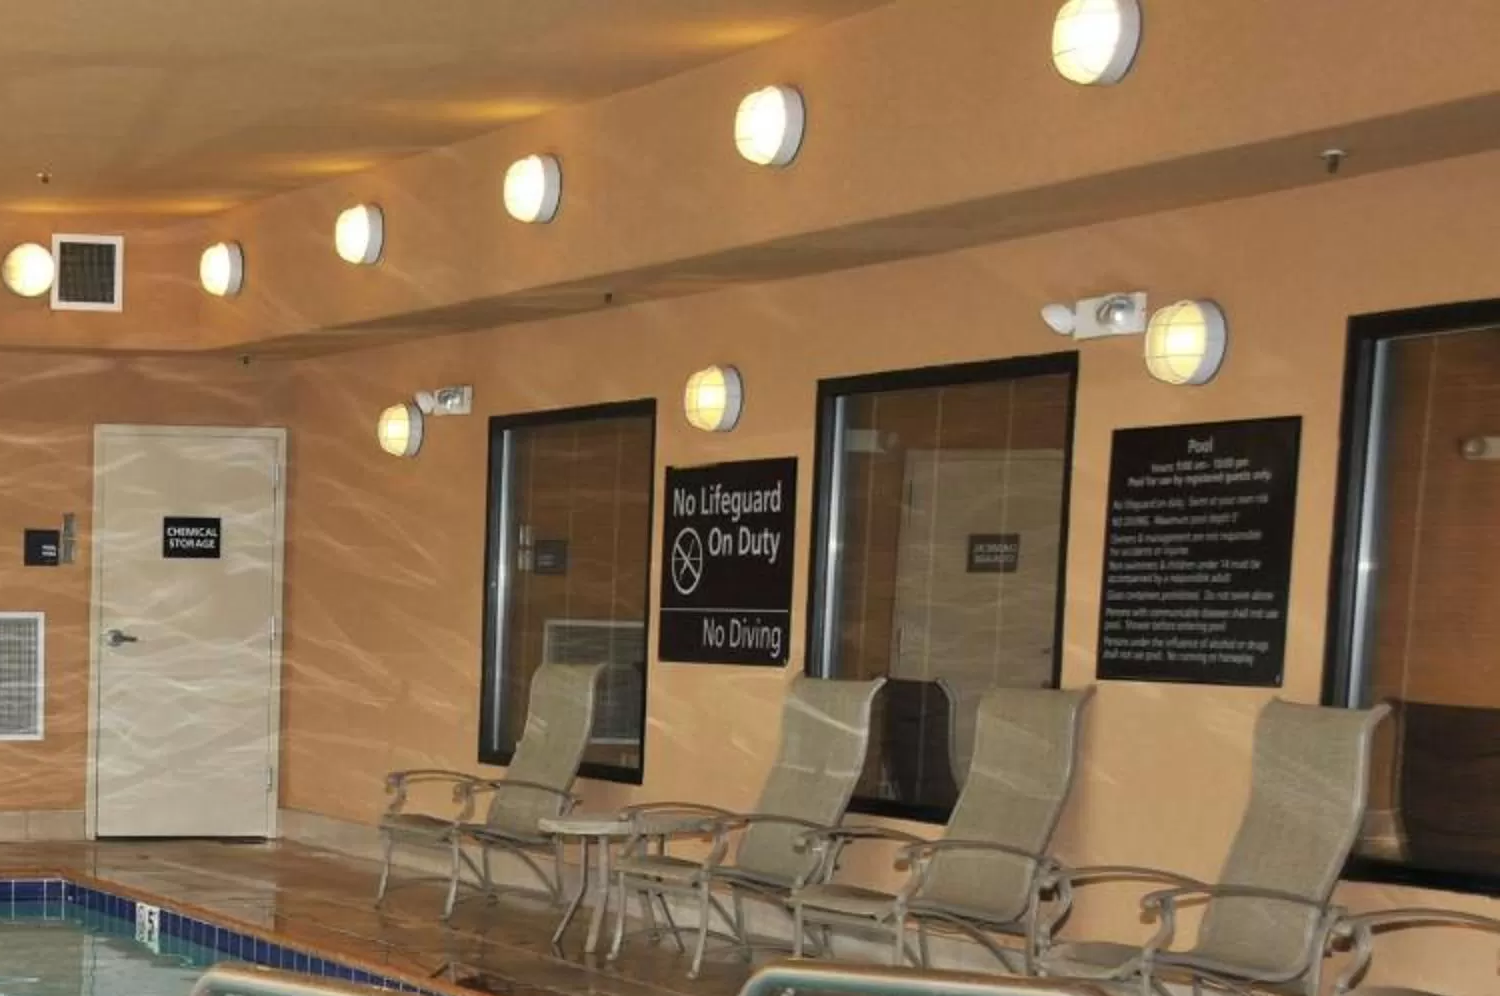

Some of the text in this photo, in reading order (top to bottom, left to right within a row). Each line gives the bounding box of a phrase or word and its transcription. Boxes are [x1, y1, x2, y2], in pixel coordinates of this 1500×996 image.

[673, 480, 782, 523] No Lifeguard
[167, 527, 219, 537] CHEMICAL
[707, 525, 781, 564] On Duty
[703, 618, 781, 658] No Diving
